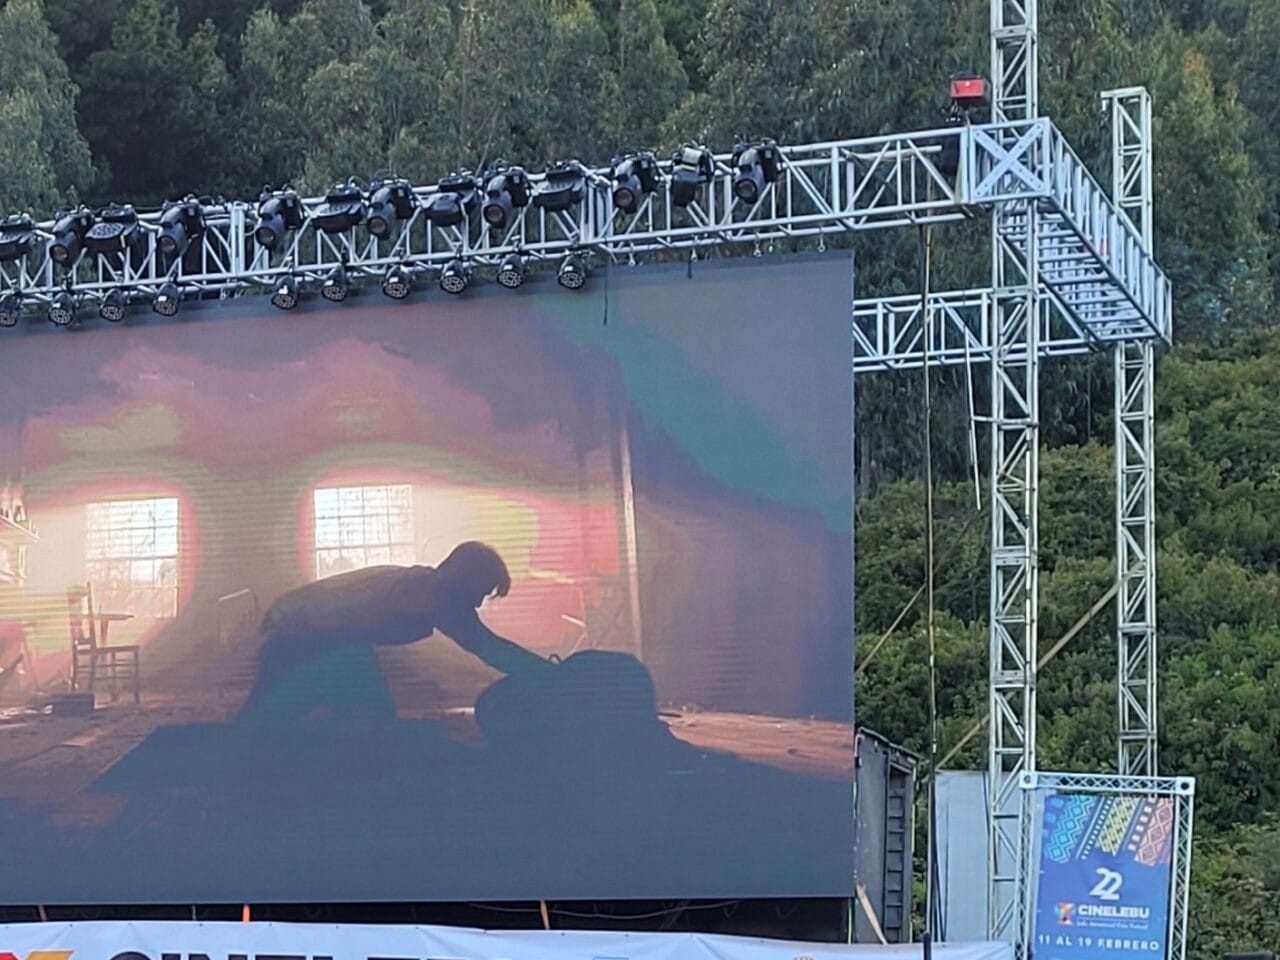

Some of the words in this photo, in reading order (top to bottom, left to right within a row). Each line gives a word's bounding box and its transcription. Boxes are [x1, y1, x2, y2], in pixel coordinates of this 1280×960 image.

[1089, 867, 1122, 900] 22
[1078, 904, 1150, 919] CINELEBU
[1039, 935, 1051, 945] 11
[1056, 936, 1072, 946] AL
[1078, 937, 1092, 947] 19
[1098, 938, 1159, 951] FEBRERO
